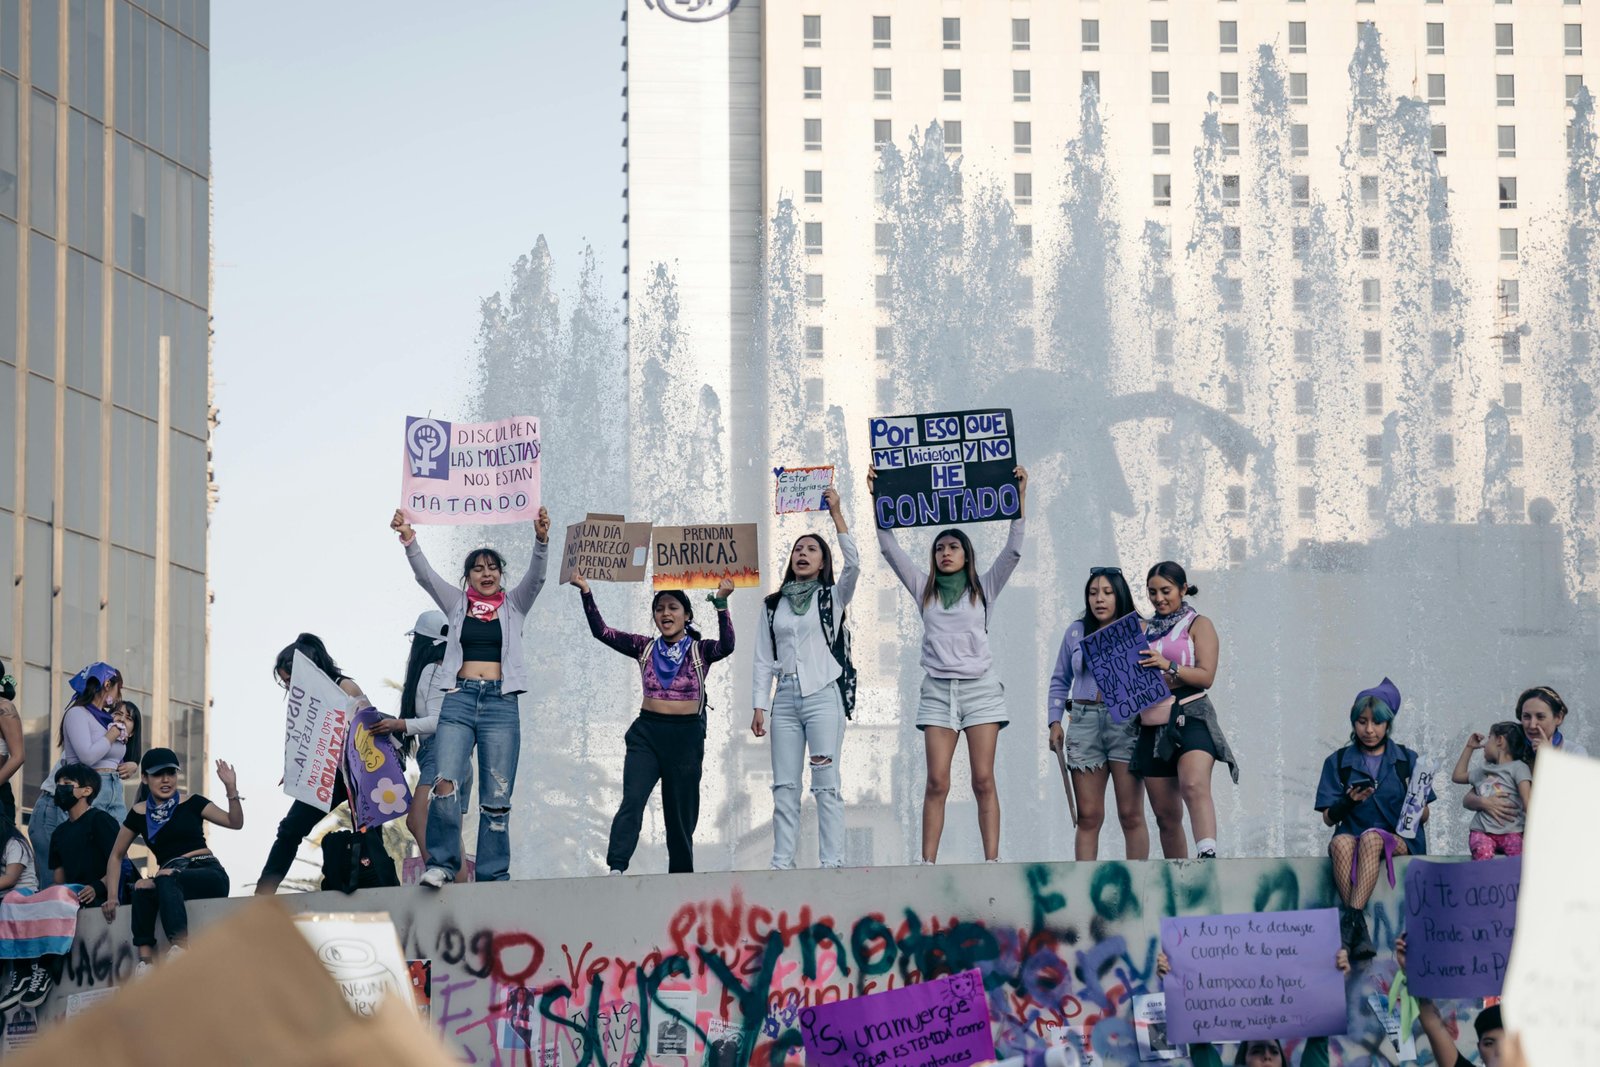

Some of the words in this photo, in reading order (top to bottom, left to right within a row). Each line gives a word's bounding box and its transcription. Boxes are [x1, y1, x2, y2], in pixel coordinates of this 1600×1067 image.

[458, 422, 536, 444] DISCULPEN
[926, 418, 958, 440] ESO
[966, 412, 1006, 435] QUE
[452, 450, 473, 467] LAS
[874, 450, 904, 467] ME
[964, 442, 976, 460] Y
[981, 440, 1010, 460] NO
[464, 473, 490, 486] NOS
[496, 466, 532, 486] ESTAN
[779, 471, 810, 483] Estar
[932, 464, 964, 488] HE
[412, 494, 526, 512] MATANDO
[876, 484, 1020, 528] CONTADO
[582, 524, 600, 538] UN
[604, 524, 622, 540] DÍA
[684, 528, 733, 541] PRENDAN
[567, 542, 577, 556] NO
[577, 540, 630, 555] APAREZCO
[656, 541, 738, 566] BARRICAS
[568, 556, 577, 569] NO
[578, 555, 627, 568] PRENDAN
[1084, 616, 1139, 656] MARCHO
[1090, 646, 1115, 668] POR
[1092, 652, 1130, 682] ESTOY
[1096, 672, 1122, 693] VIVA
[1104, 688, 1121, 708] SE
[1124, 670, 1160, 698] HASTA
[1119, 682, 1166, 718] CUANDO
[1408, 870, 1430, 916] Si
[1434, 874, 1458, 908] te
[1465, 883, 1519, 908] acosa
[1224, 926, 1240, 944] no
[1248, 920, 1263, 934] te
[1422, 916, 1463, 942] Prende
[1472, 928, 1489, 942] un
[1191, 943, 1239, 960] cuando
[1244, 942, 1256, 956] te
[1261, 942, 1272, 956] lo
[1418, 954, 1434, 977] Si
[1438, 965, 1466, 976] viene
[1472, 956, 1488, 974] la
[1198, 972, 1256, 992] tampoco
[1260, 973, 1274, 990] lo
[1184, 997, 1236, 1012] cuando
[1240, 994, 1274, 1008] cuente
[1280, 994, 1294, 1005] lo
[820, 1024, 848, 1056] Si
[854, 1020, 893, 1048] una
[893, 1004, 940, 1036] mujer
[940, 999, 971, 1027] que
[1192, 1018, 1210, 1036] que
[1230, 1020, 1246, 1030] me
[1247, 1014, 1278, 1031] hiciste
[1280, 1016, 1288, 1024] a
[893, 1042, 910, 1058] ES
[910, 1028, 952, 1052] TEMIDA
[956, 1020, 986, 1038] como
